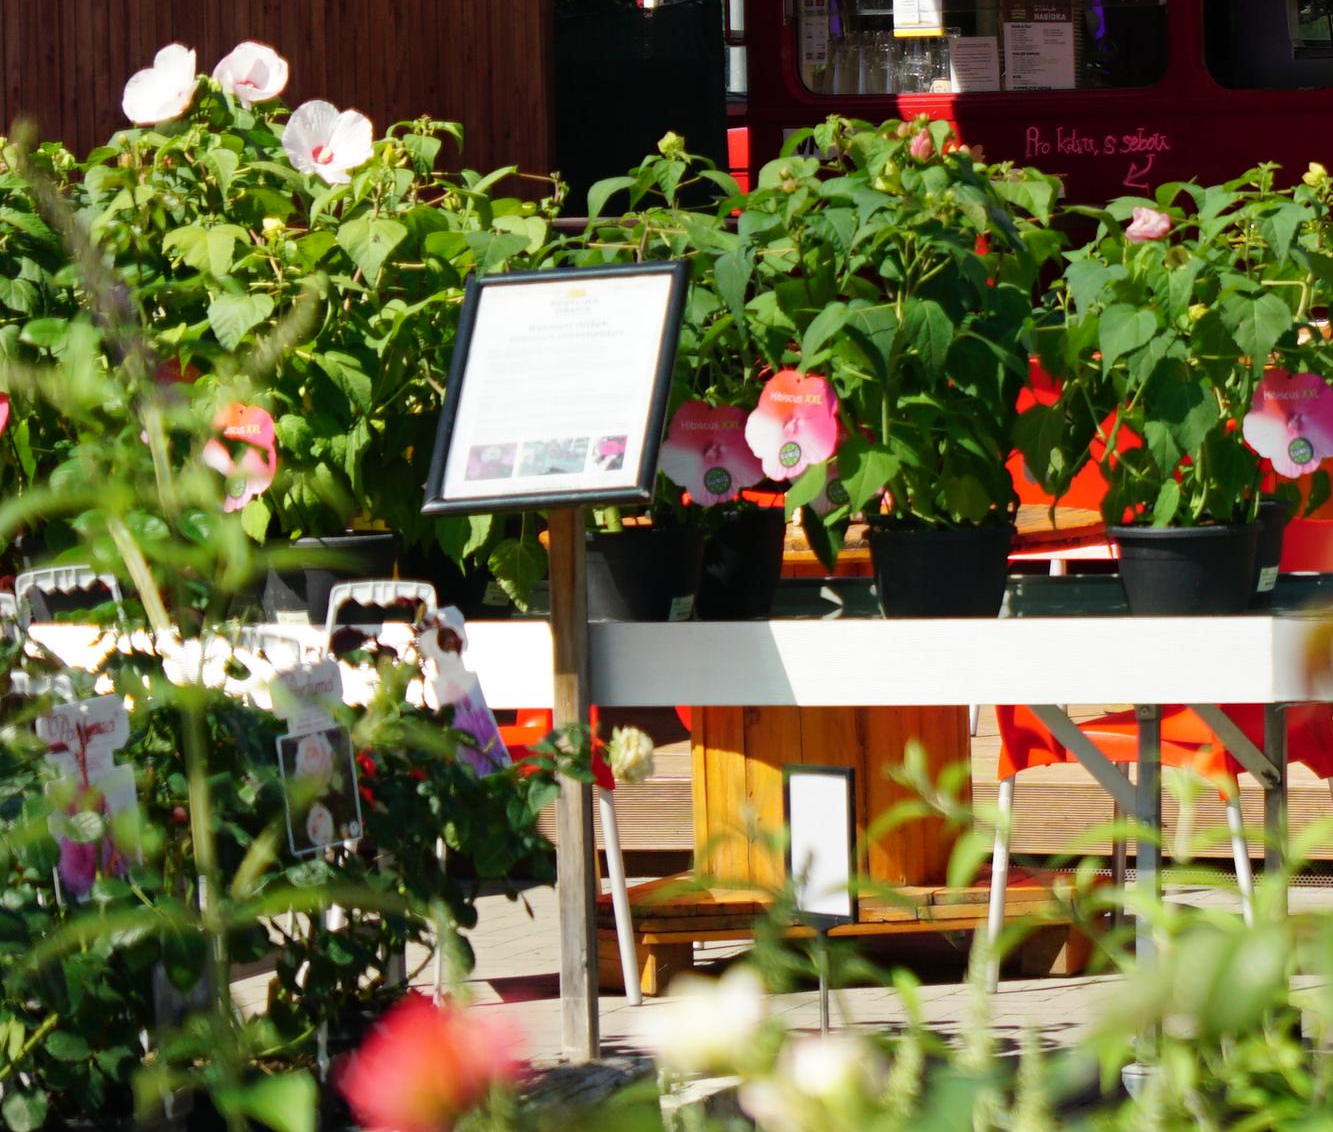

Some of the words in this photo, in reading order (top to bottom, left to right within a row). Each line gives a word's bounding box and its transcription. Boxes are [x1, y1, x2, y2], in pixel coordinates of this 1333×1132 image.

[1025, 126, 1051, 158] Pro
[1104, 135, 1118, 154] s
[770, 391, 802, 404] Hibiscus
[804, 393, 823, 405] XXL
[680, 419, 720, 431] Hibiscus
[721, 420, 741, 431] XXL
